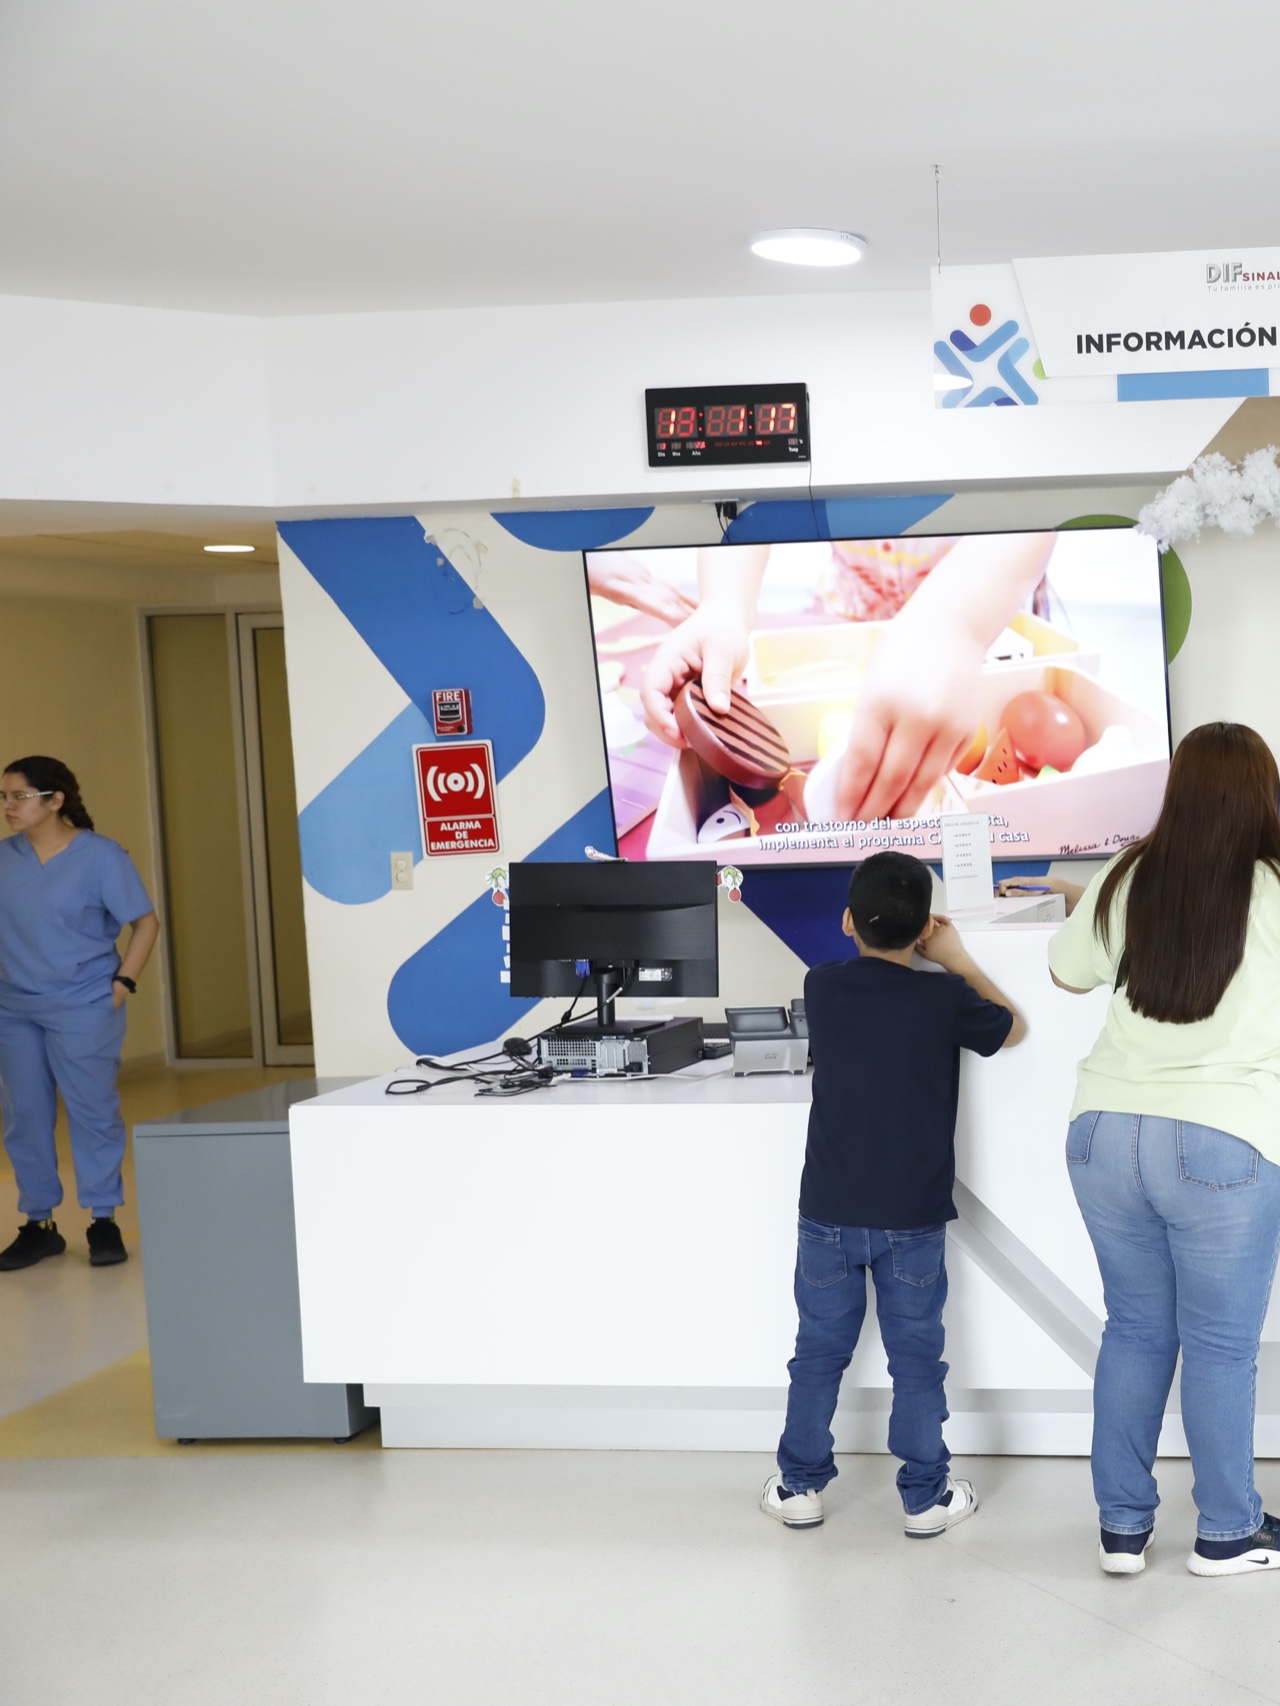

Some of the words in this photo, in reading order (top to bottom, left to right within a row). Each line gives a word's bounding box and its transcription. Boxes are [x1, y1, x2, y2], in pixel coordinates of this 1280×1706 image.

[1206, 262, 1242, 284] DIF
[1076, 322, 1278, 354] INFORMACIÓN
[436, 691, 460, 701] FIRE
[440, 821, 481, 831] ALARMA
[775, 822, 800, 833] con
[804, 820, 867, 832] trastorno
[870, 816, 891, 830] del
[896, 816, 941, 831] espect
[455, 831, 468, 839] DE
[430, 839, 495, 851] EMERGENCIA
[759, 836, 839, 852] implementa
[842, 835, 854, 848] el
[859, 834, 925, 850] programa
[999, 831, 1030, 842] casa
[1059, 843, 1101, 855] Melissa
